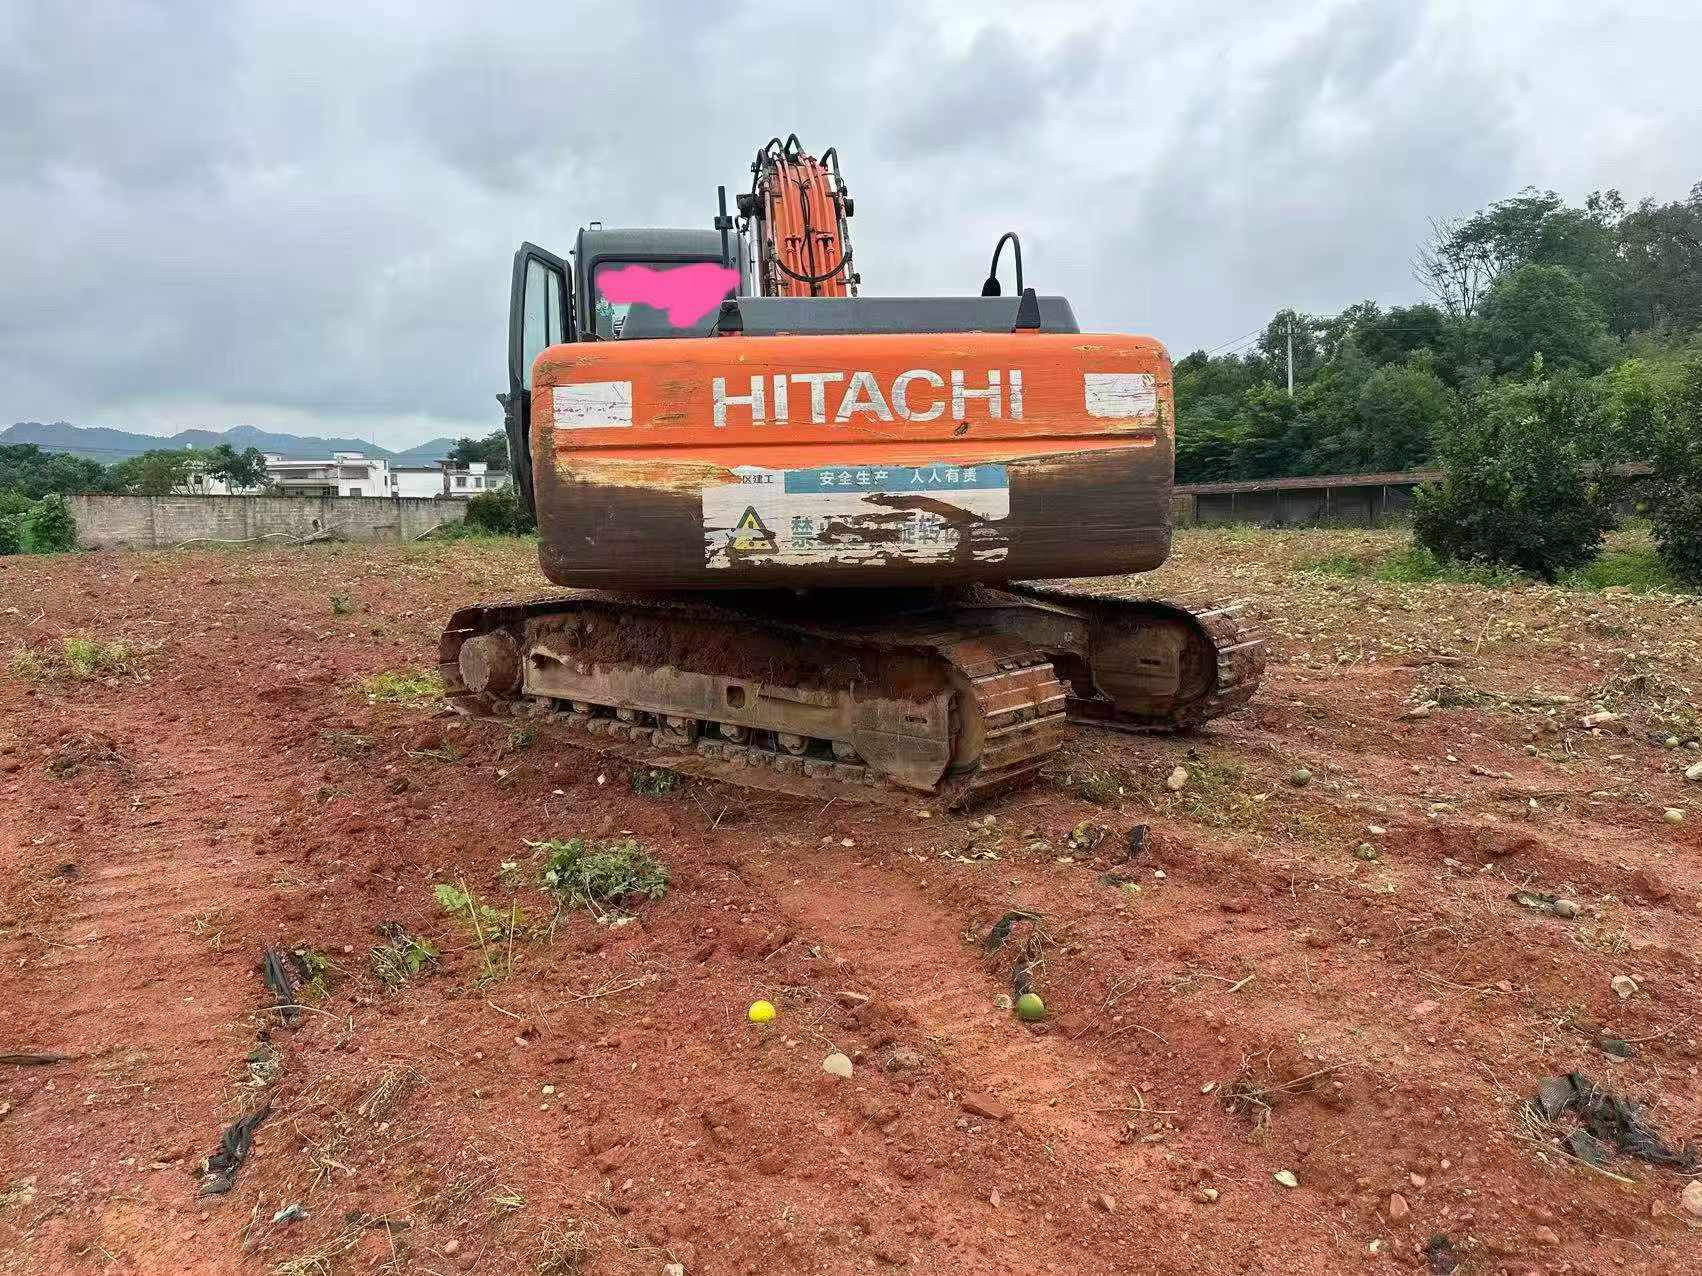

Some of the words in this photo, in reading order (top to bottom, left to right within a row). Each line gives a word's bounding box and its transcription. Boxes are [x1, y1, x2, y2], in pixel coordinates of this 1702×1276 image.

[712, 369, 1023, 427] HITACHI
[819, 470, 889, 486] 安全生产
[910, 467, 977, 484] 人人有责
